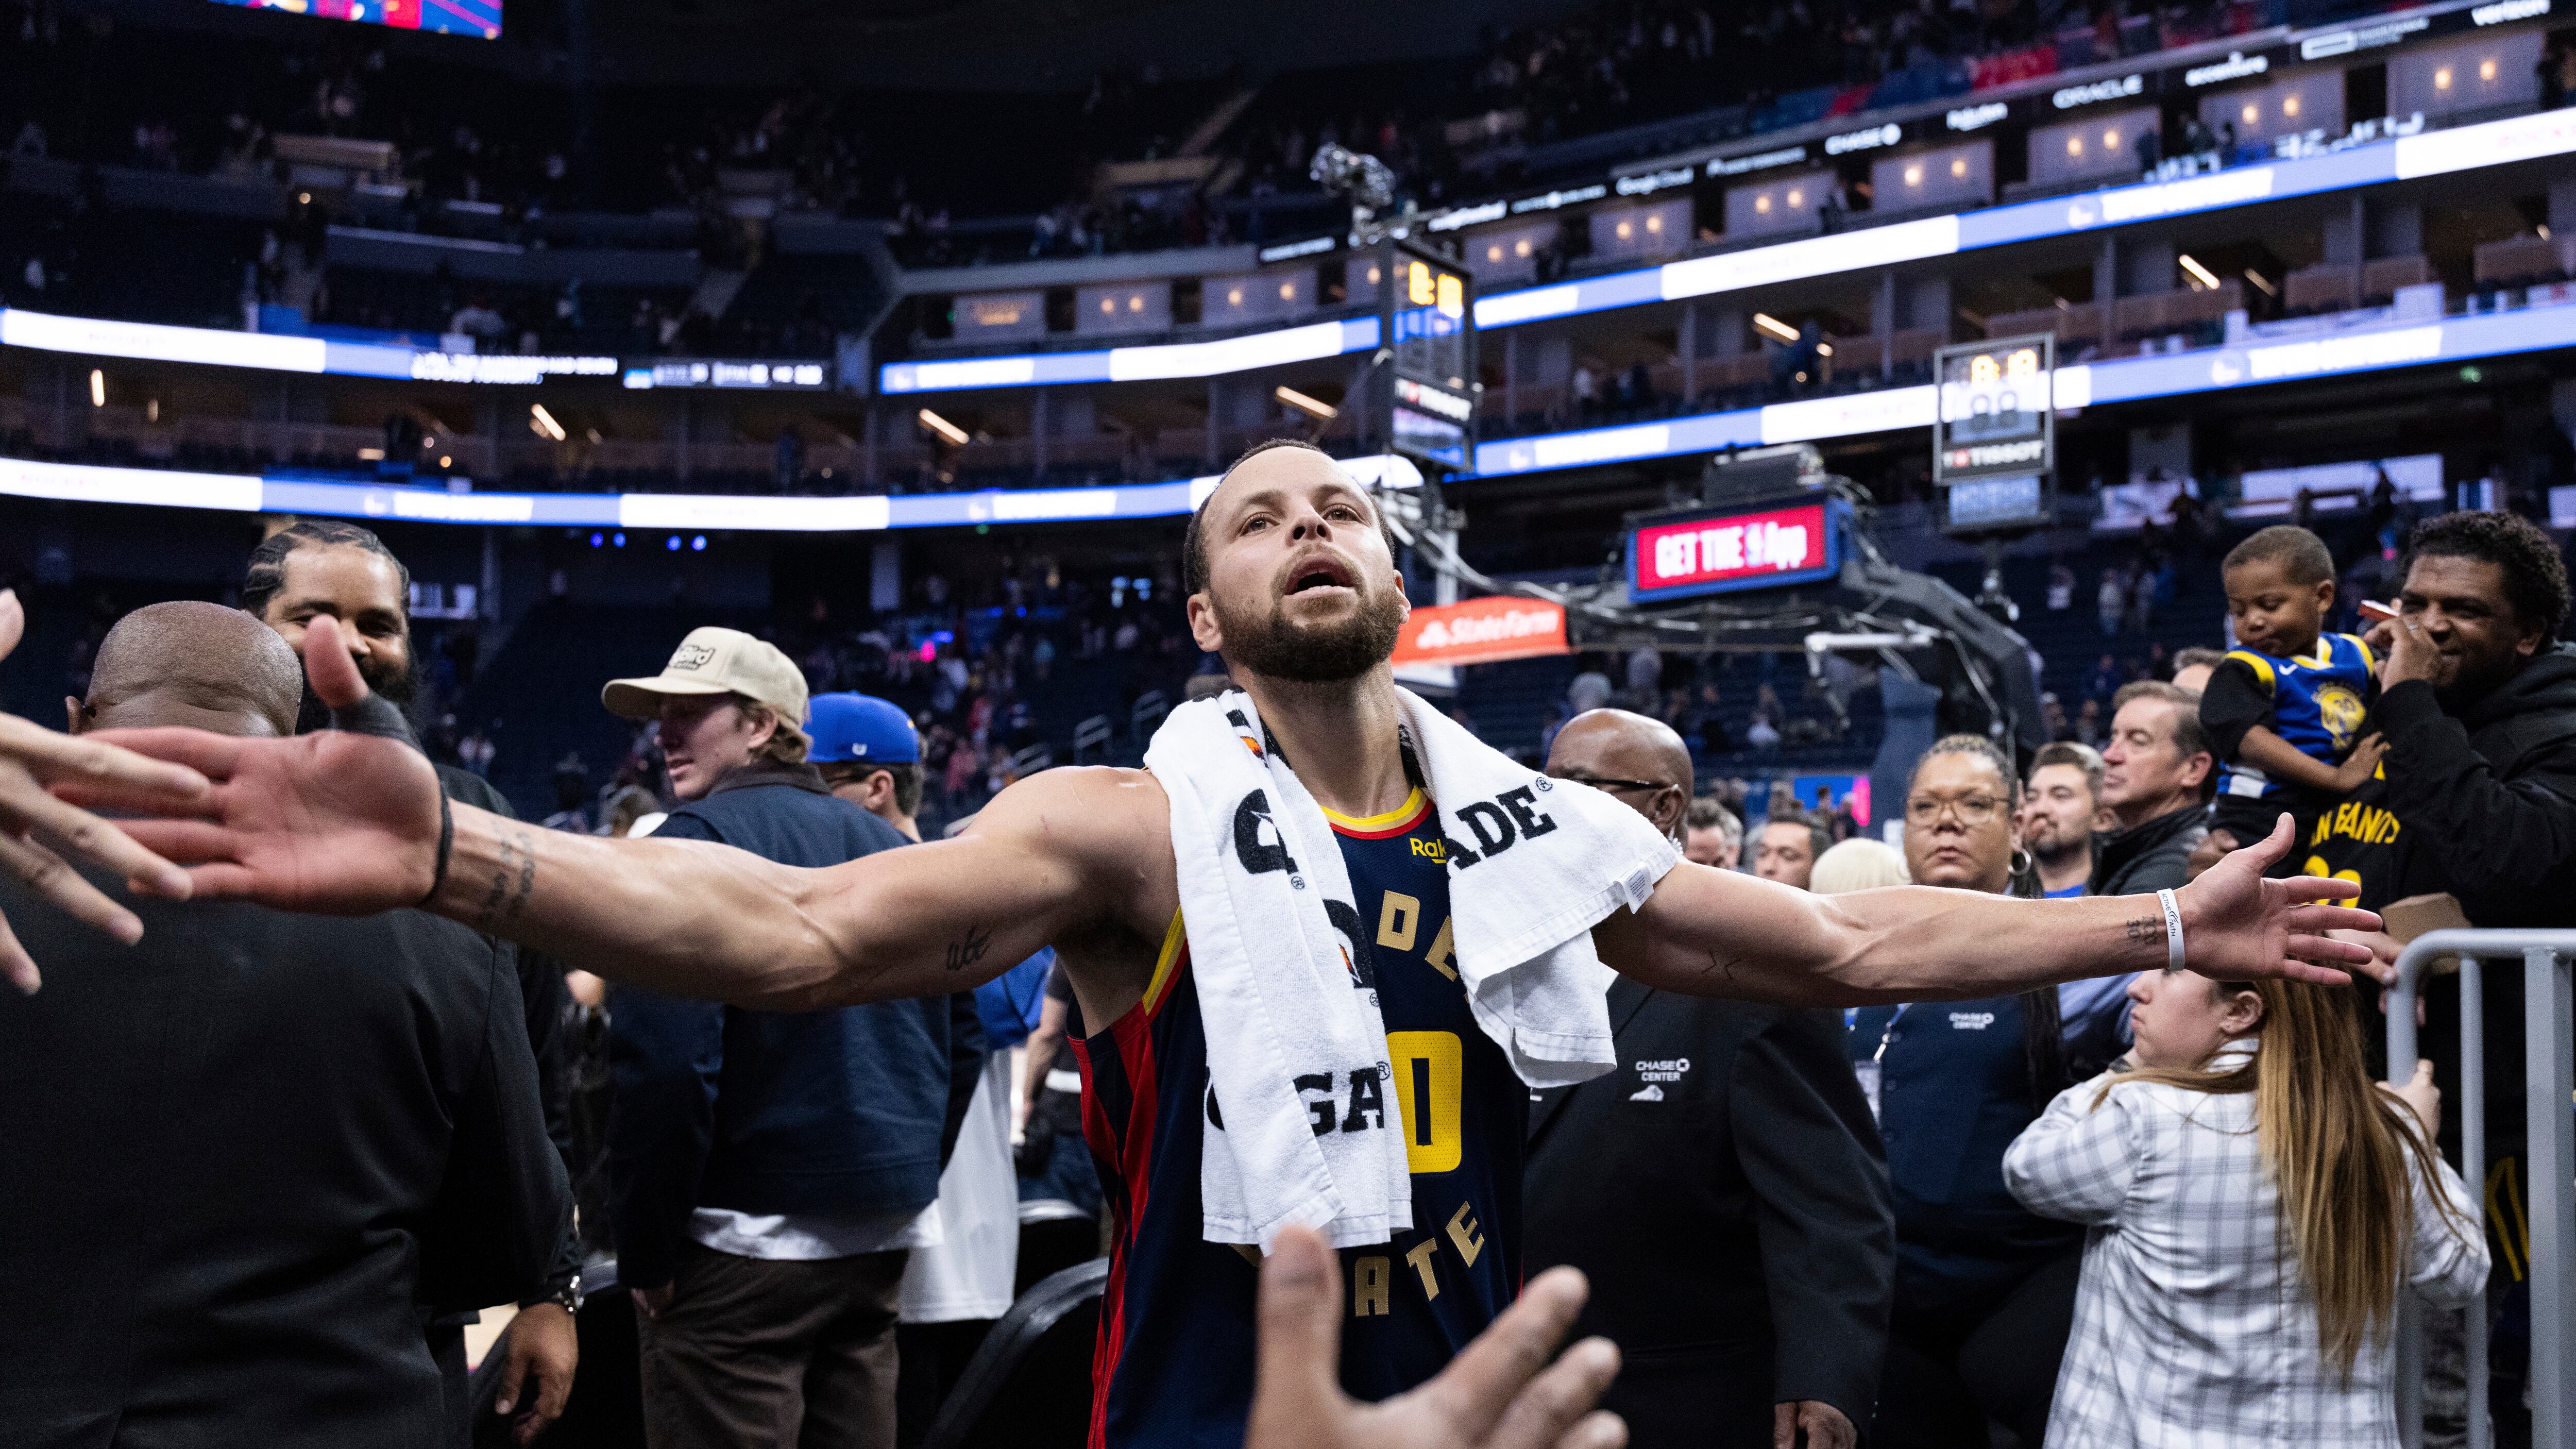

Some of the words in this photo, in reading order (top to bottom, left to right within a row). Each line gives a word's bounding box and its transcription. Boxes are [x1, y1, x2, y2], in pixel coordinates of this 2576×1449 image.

[1655, 533, 1697, 578] GET
[1635, 1060, 1675, 1071] CHASE
[1641, 1071, 1681, 1081] CENTER
